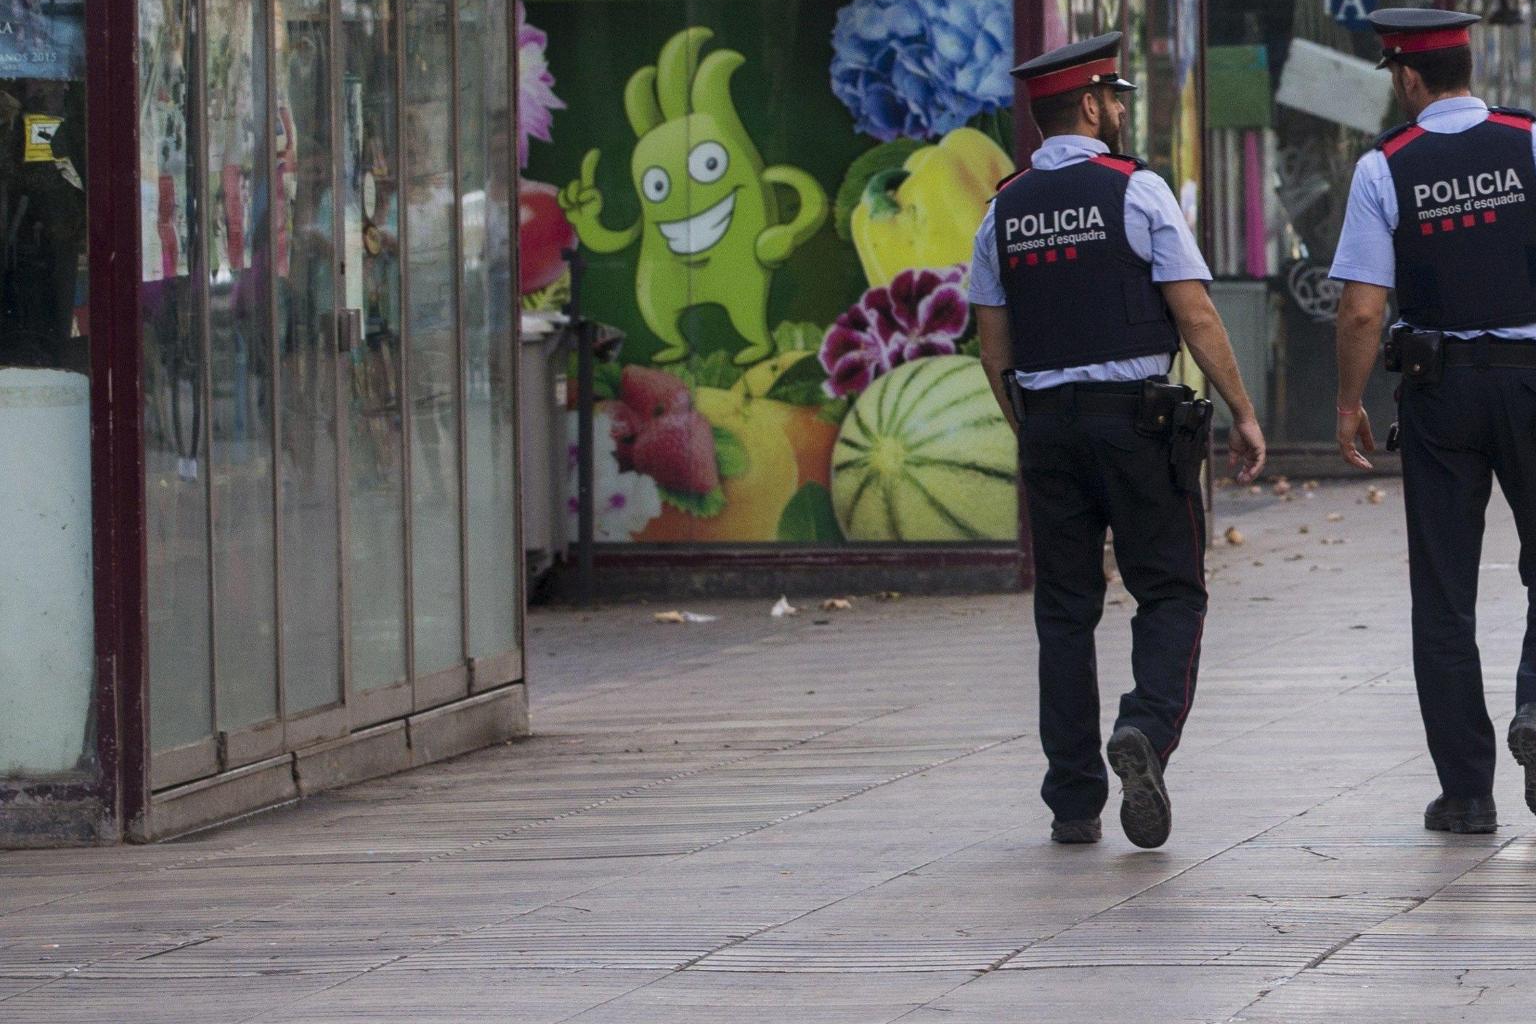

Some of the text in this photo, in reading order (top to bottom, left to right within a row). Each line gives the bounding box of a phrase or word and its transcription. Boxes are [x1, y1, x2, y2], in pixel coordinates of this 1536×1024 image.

[1414, 168, 1524, 207] POLICIA
[1005, 206, 1105, 240] POLICIA
[1418, 203, 1462, 220] mossos
[1006, 237, 1046, 253] mossos
